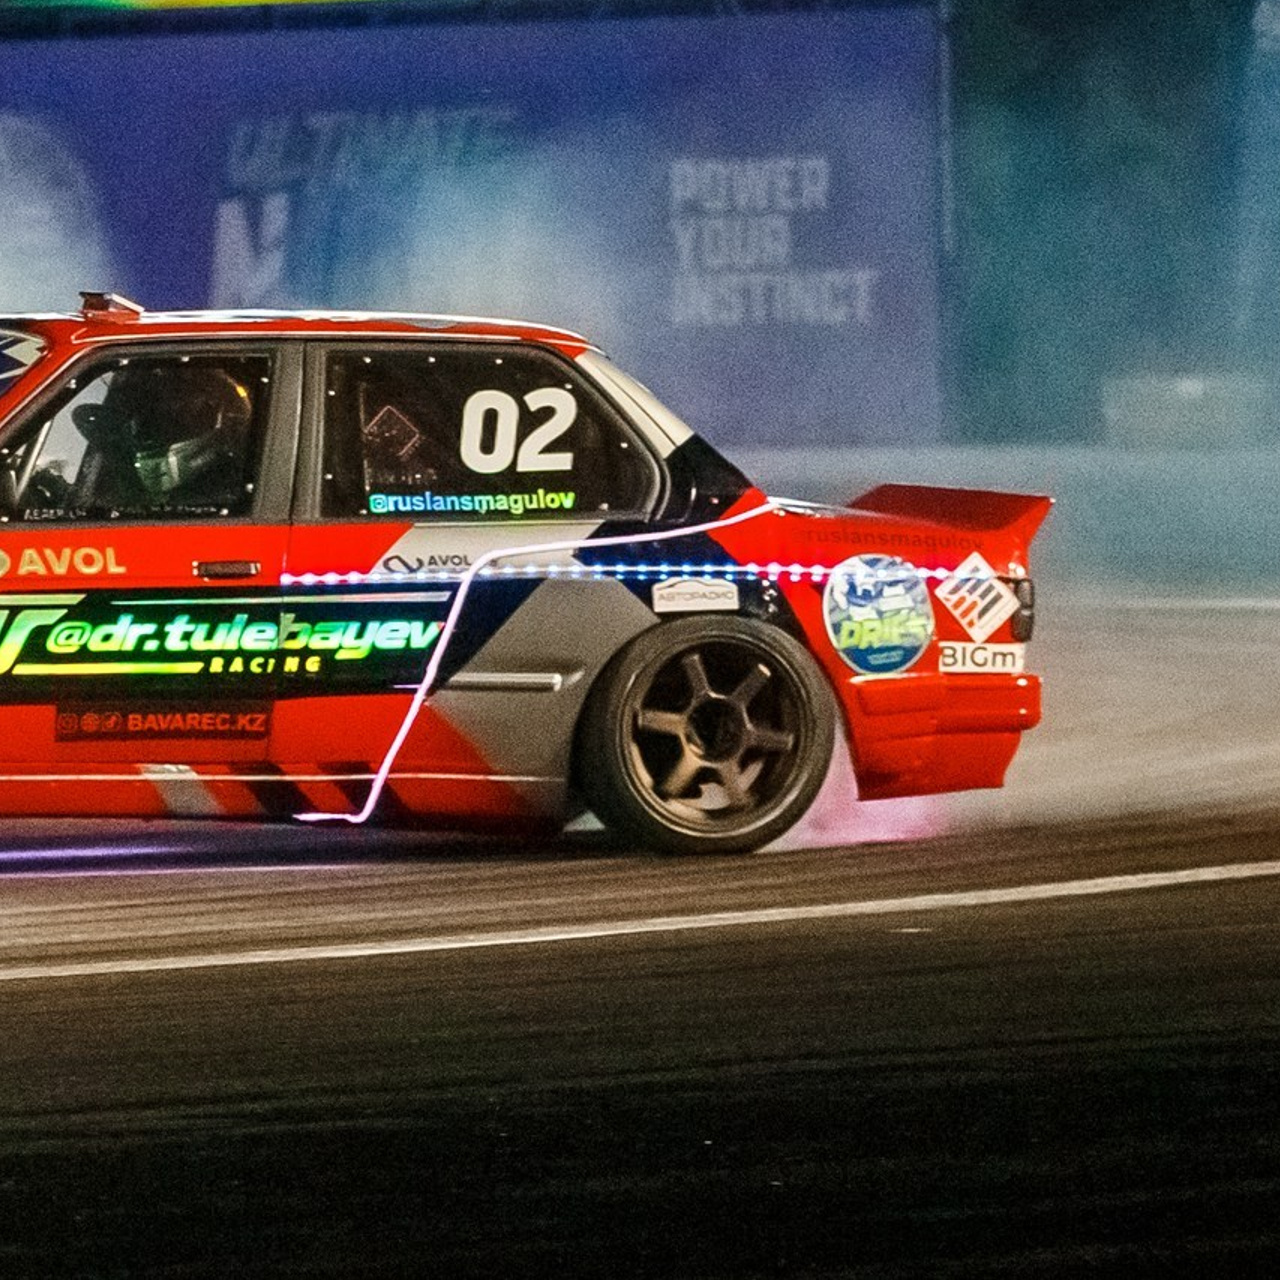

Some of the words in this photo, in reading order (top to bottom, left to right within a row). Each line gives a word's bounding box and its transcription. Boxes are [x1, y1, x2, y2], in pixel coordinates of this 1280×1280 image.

[670, 156, 829, 208] POWER
[671, 217, 790, 267] YOUR
[670, 270, 879, 322] INSTINCT
[460, 387, 577, 473] 02
[18, 547, 127, 575] AVOL
[428, 555, 472, 566] AVOL
[46, 613, 445, 660] @dr.tulebayev
[209, 656, 321, 673] RACING
[127, 712, 267, 732] BAVAREC.KZ
